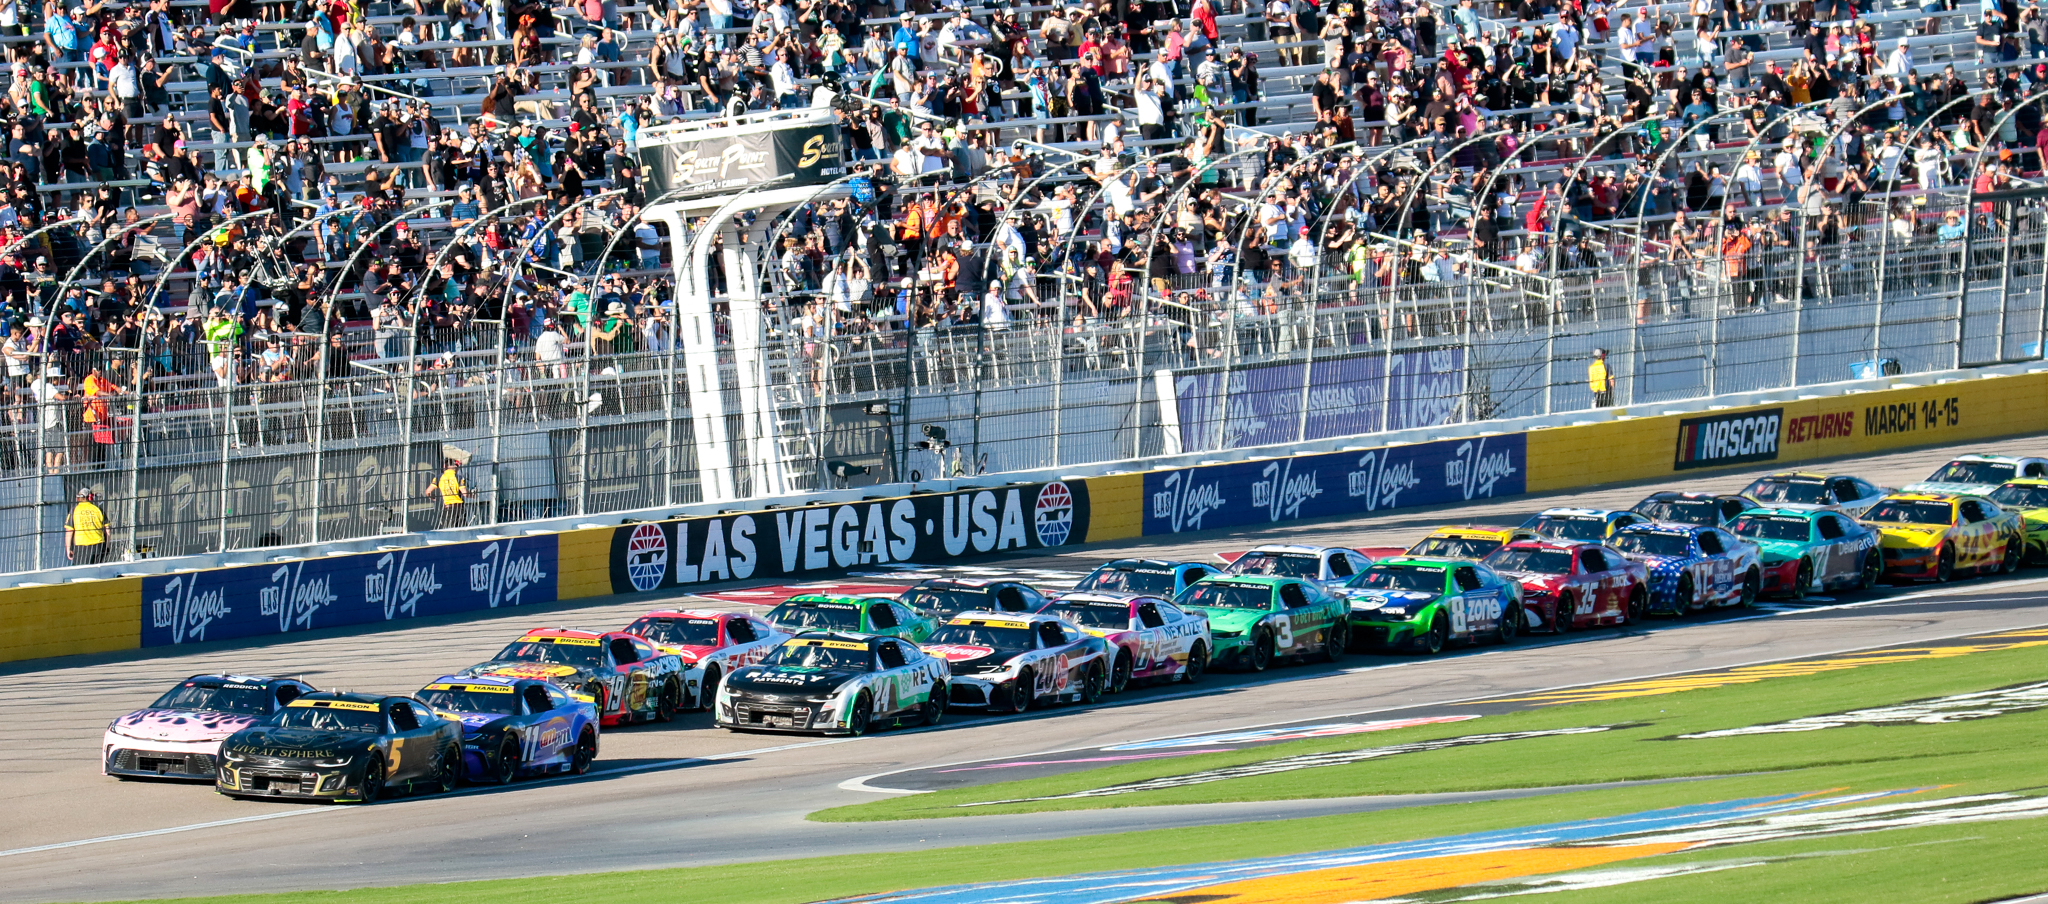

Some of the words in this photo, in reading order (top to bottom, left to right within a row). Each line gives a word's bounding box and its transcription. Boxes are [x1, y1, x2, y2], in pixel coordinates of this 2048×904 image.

[672, 150, 722, 184] SOUTH
[720, 143, 770, 179] POINT
[821, 167, 838, 176] HOTEL
[722, 178, 748, 188] CASINO
[1268, 385, 1383, 421] VISITASVEGAS.COM
[1702, 414, 1779, 459] NASCAR
[1787, 411, 1854, 444] RETURNS
[1865, 402, 1916, 436] MARCH
[1922, 397, 1959, 429] 14-15
[1349, 470, 1366, 496] LAS
[1359, 449, 1420, 511] Vegas
[1446, 460, 1464, 486] LAS
[1457, 438, 1516, 500] Vegas
[1154, 491, 1171, 518] LAS
[1165, 469, 1226, 533] Vegas
[1252, 481, 1270, 507] LAS
[1263, 458, 1323, 522] Vegas
[676, 514, 757, 584] LAS
[776, 498, 916, 573] VEGAS
[943, 488, 1027, 556] USA
[1838, 537, 1874, 556] Delaware
[1958, 529, 1980, 563] 34
[366, 572, 384, 602] LAS
[377, 550, 442, 620] Vegas
[471, 562, 489, 592] LAS
[482, 539, 546, 607] Vegas
[153, 598, 172, 628] LAS
[165, 573, 231, 644] Vegas
[261, 586, 279, 616] LAS
[272, 561, 338, 632] Vegas
[1451, 596, 1467, 632] 8
[1467, 598, 1502, 622] zone
[1576, 582, 1599, 614] 35
[1276, 614, 1294, 648] 3
[1134, 632, 1155, 672] 6
[746, 672, 826, 682] RELAY
[753, 677, 804, 686] PAYMENTS
[1035, 654, 1057, 694] 20
[334, 702, 370, 710] LARSON
[604, 675, 626, 712] 19
[873, 677, 892, 712] 24
[233, 744, 258, 755] LIVE
[259, 748, 276, 756] AT
[280, 749, 335, 759] SPHERE
[388, 738, 404, 772] 5
[522, 726, 540, 762] 11
[540, 727, 574, 755] ampm
